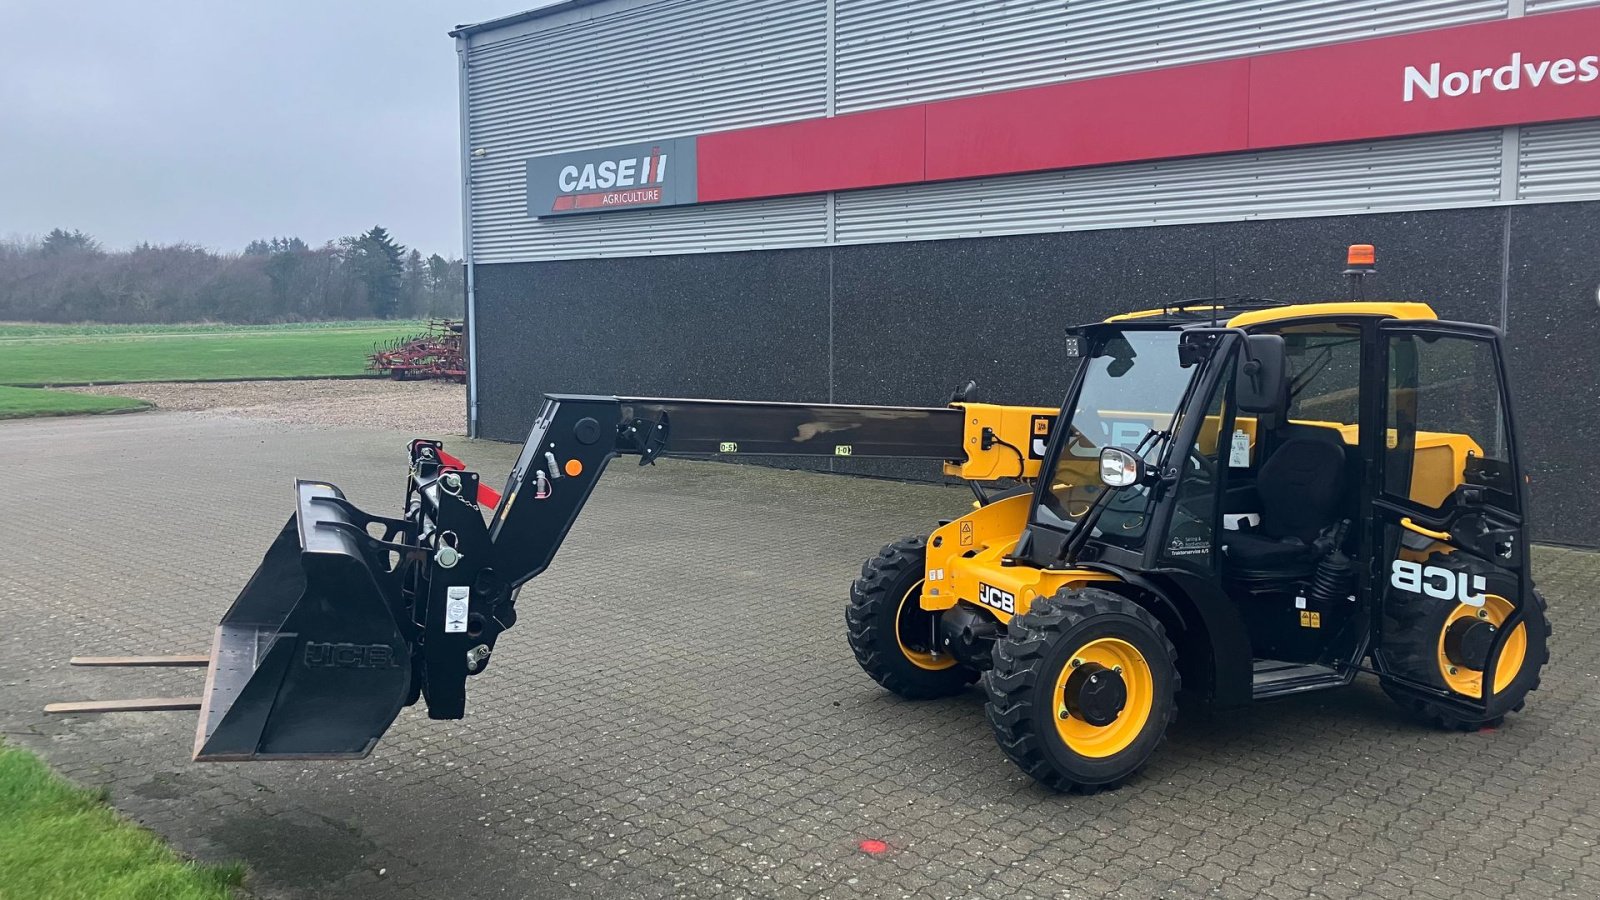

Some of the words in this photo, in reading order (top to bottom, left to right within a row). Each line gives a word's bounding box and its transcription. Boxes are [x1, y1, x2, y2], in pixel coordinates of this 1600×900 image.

[558, 158, 637, 192] CASE
[602, 190, 659, 204] AGRICULTURE
[979, 584, 1014, 614] JCB
[304, 641, 394, 668] JCB
